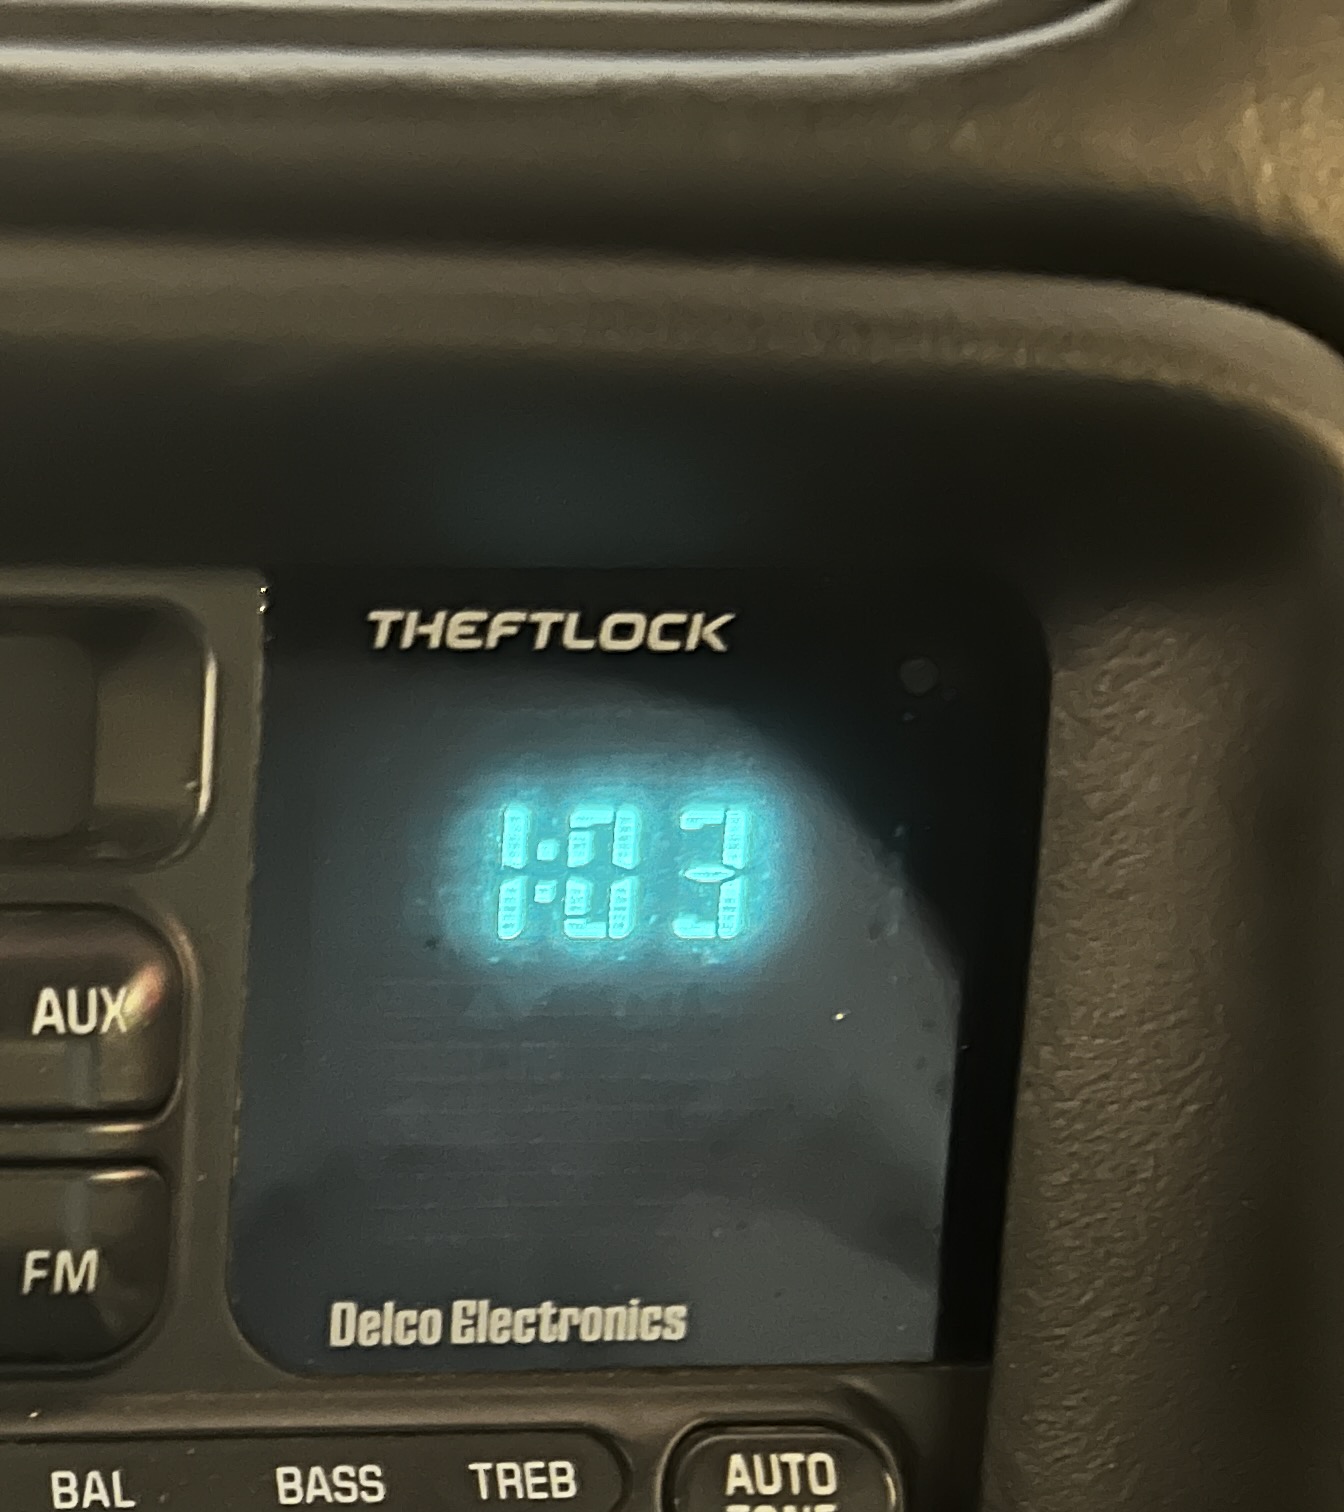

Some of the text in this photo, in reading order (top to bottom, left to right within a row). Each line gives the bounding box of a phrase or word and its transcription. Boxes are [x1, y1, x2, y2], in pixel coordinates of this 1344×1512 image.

[367, 609, 734, 653] THEFTLOCK
[494, 799, 750, 942] 1:03
[31, 987, 130, 1036] AUX
[21, 1249, 99, 1296] FM
[329, 1299, 688, 1349] Delco Electronics
[50, 1470, 136, 1511] BAL
[276, 1464, 387, 1505] BASS
[468, 1461, 578, 1502] TREB
[726, 1453, 838, 1500] AUTO
